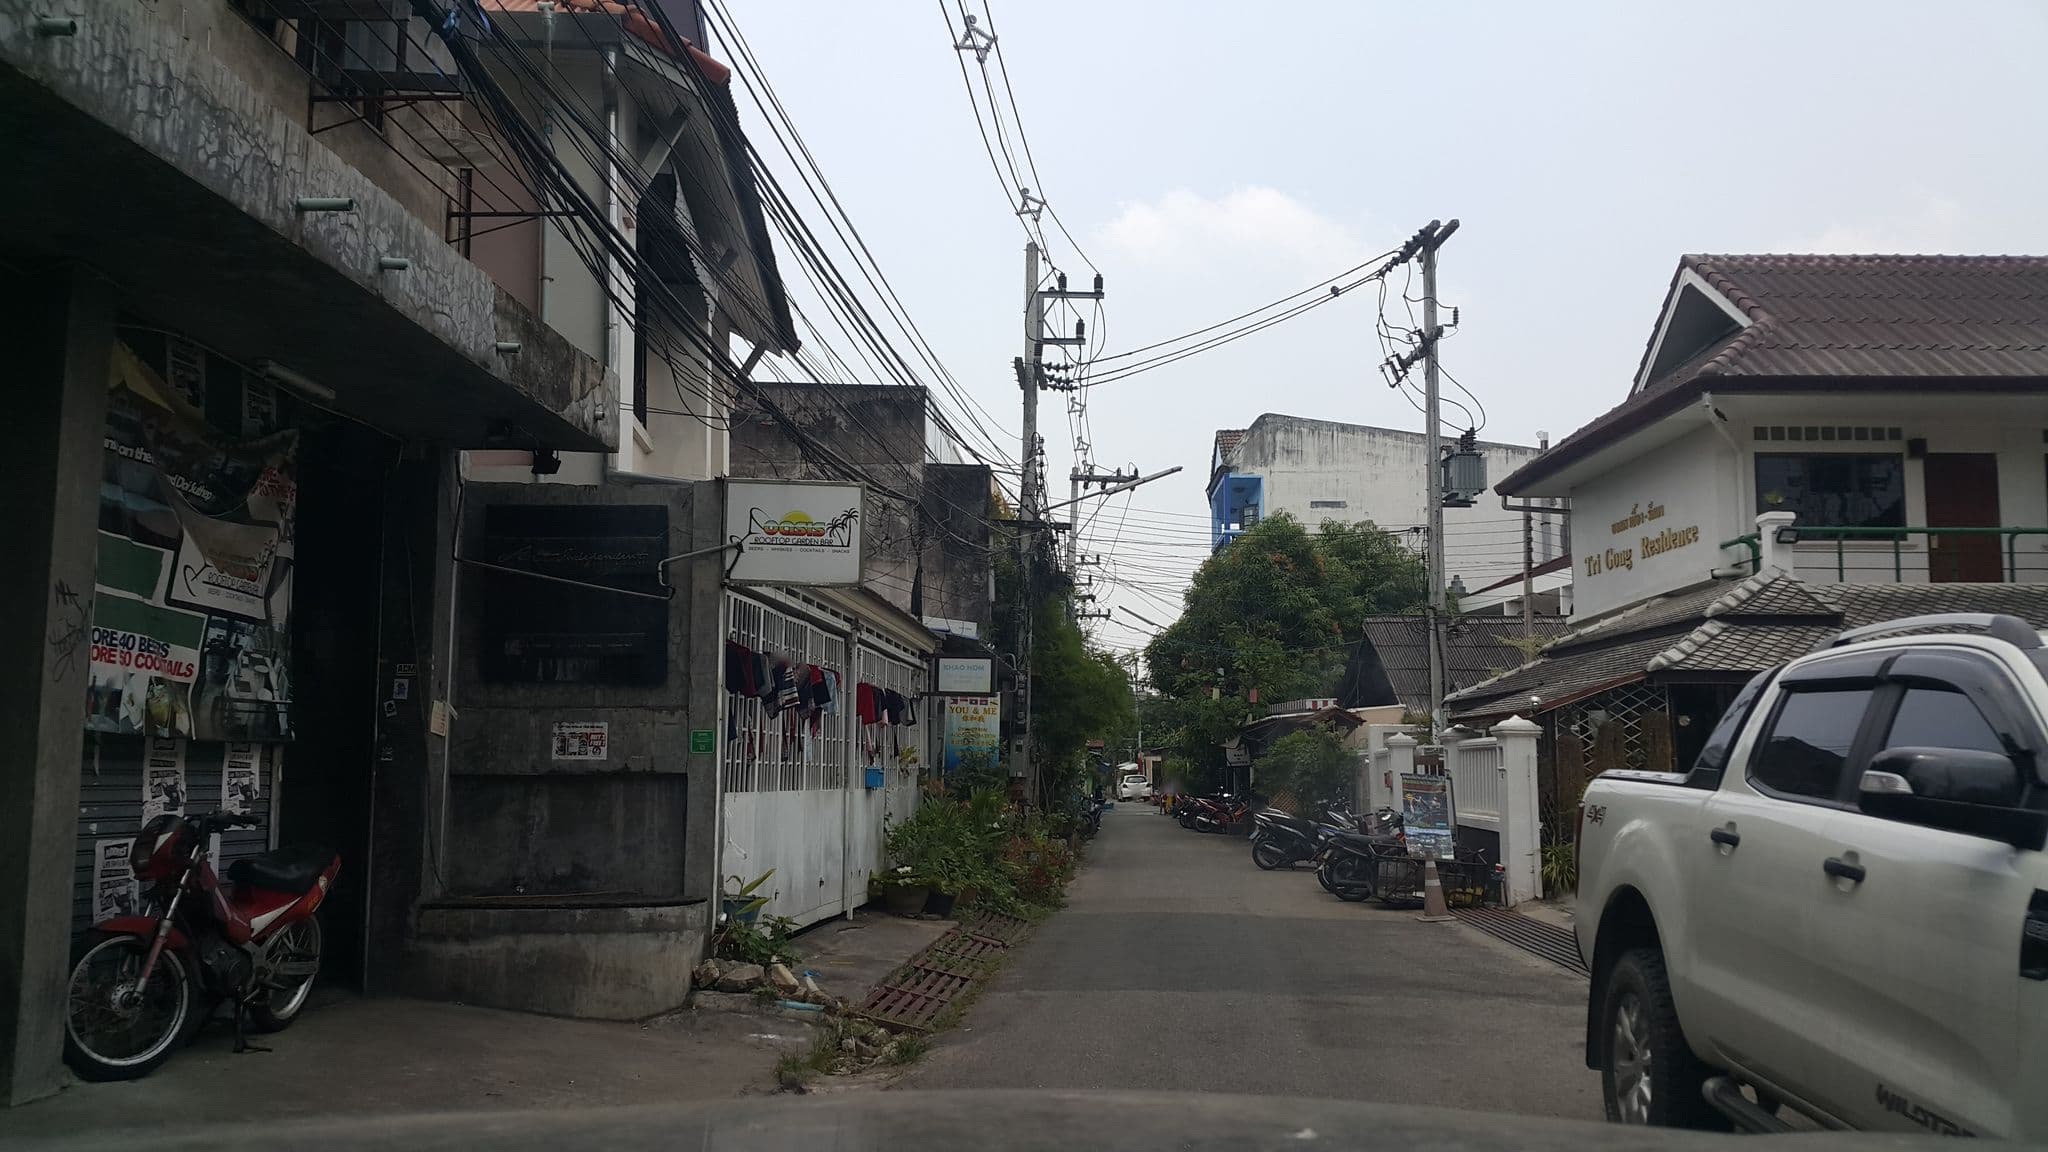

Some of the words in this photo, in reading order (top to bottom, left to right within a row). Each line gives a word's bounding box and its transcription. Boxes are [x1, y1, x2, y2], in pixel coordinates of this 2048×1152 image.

[1584, 554, 1601, 576] Tri
[1641, 525, 1699, 559] Residence
[119, 633, 136, 651] 40
[949, 706, 969, 714] YOU
[983, 707, 997, 715] ME
